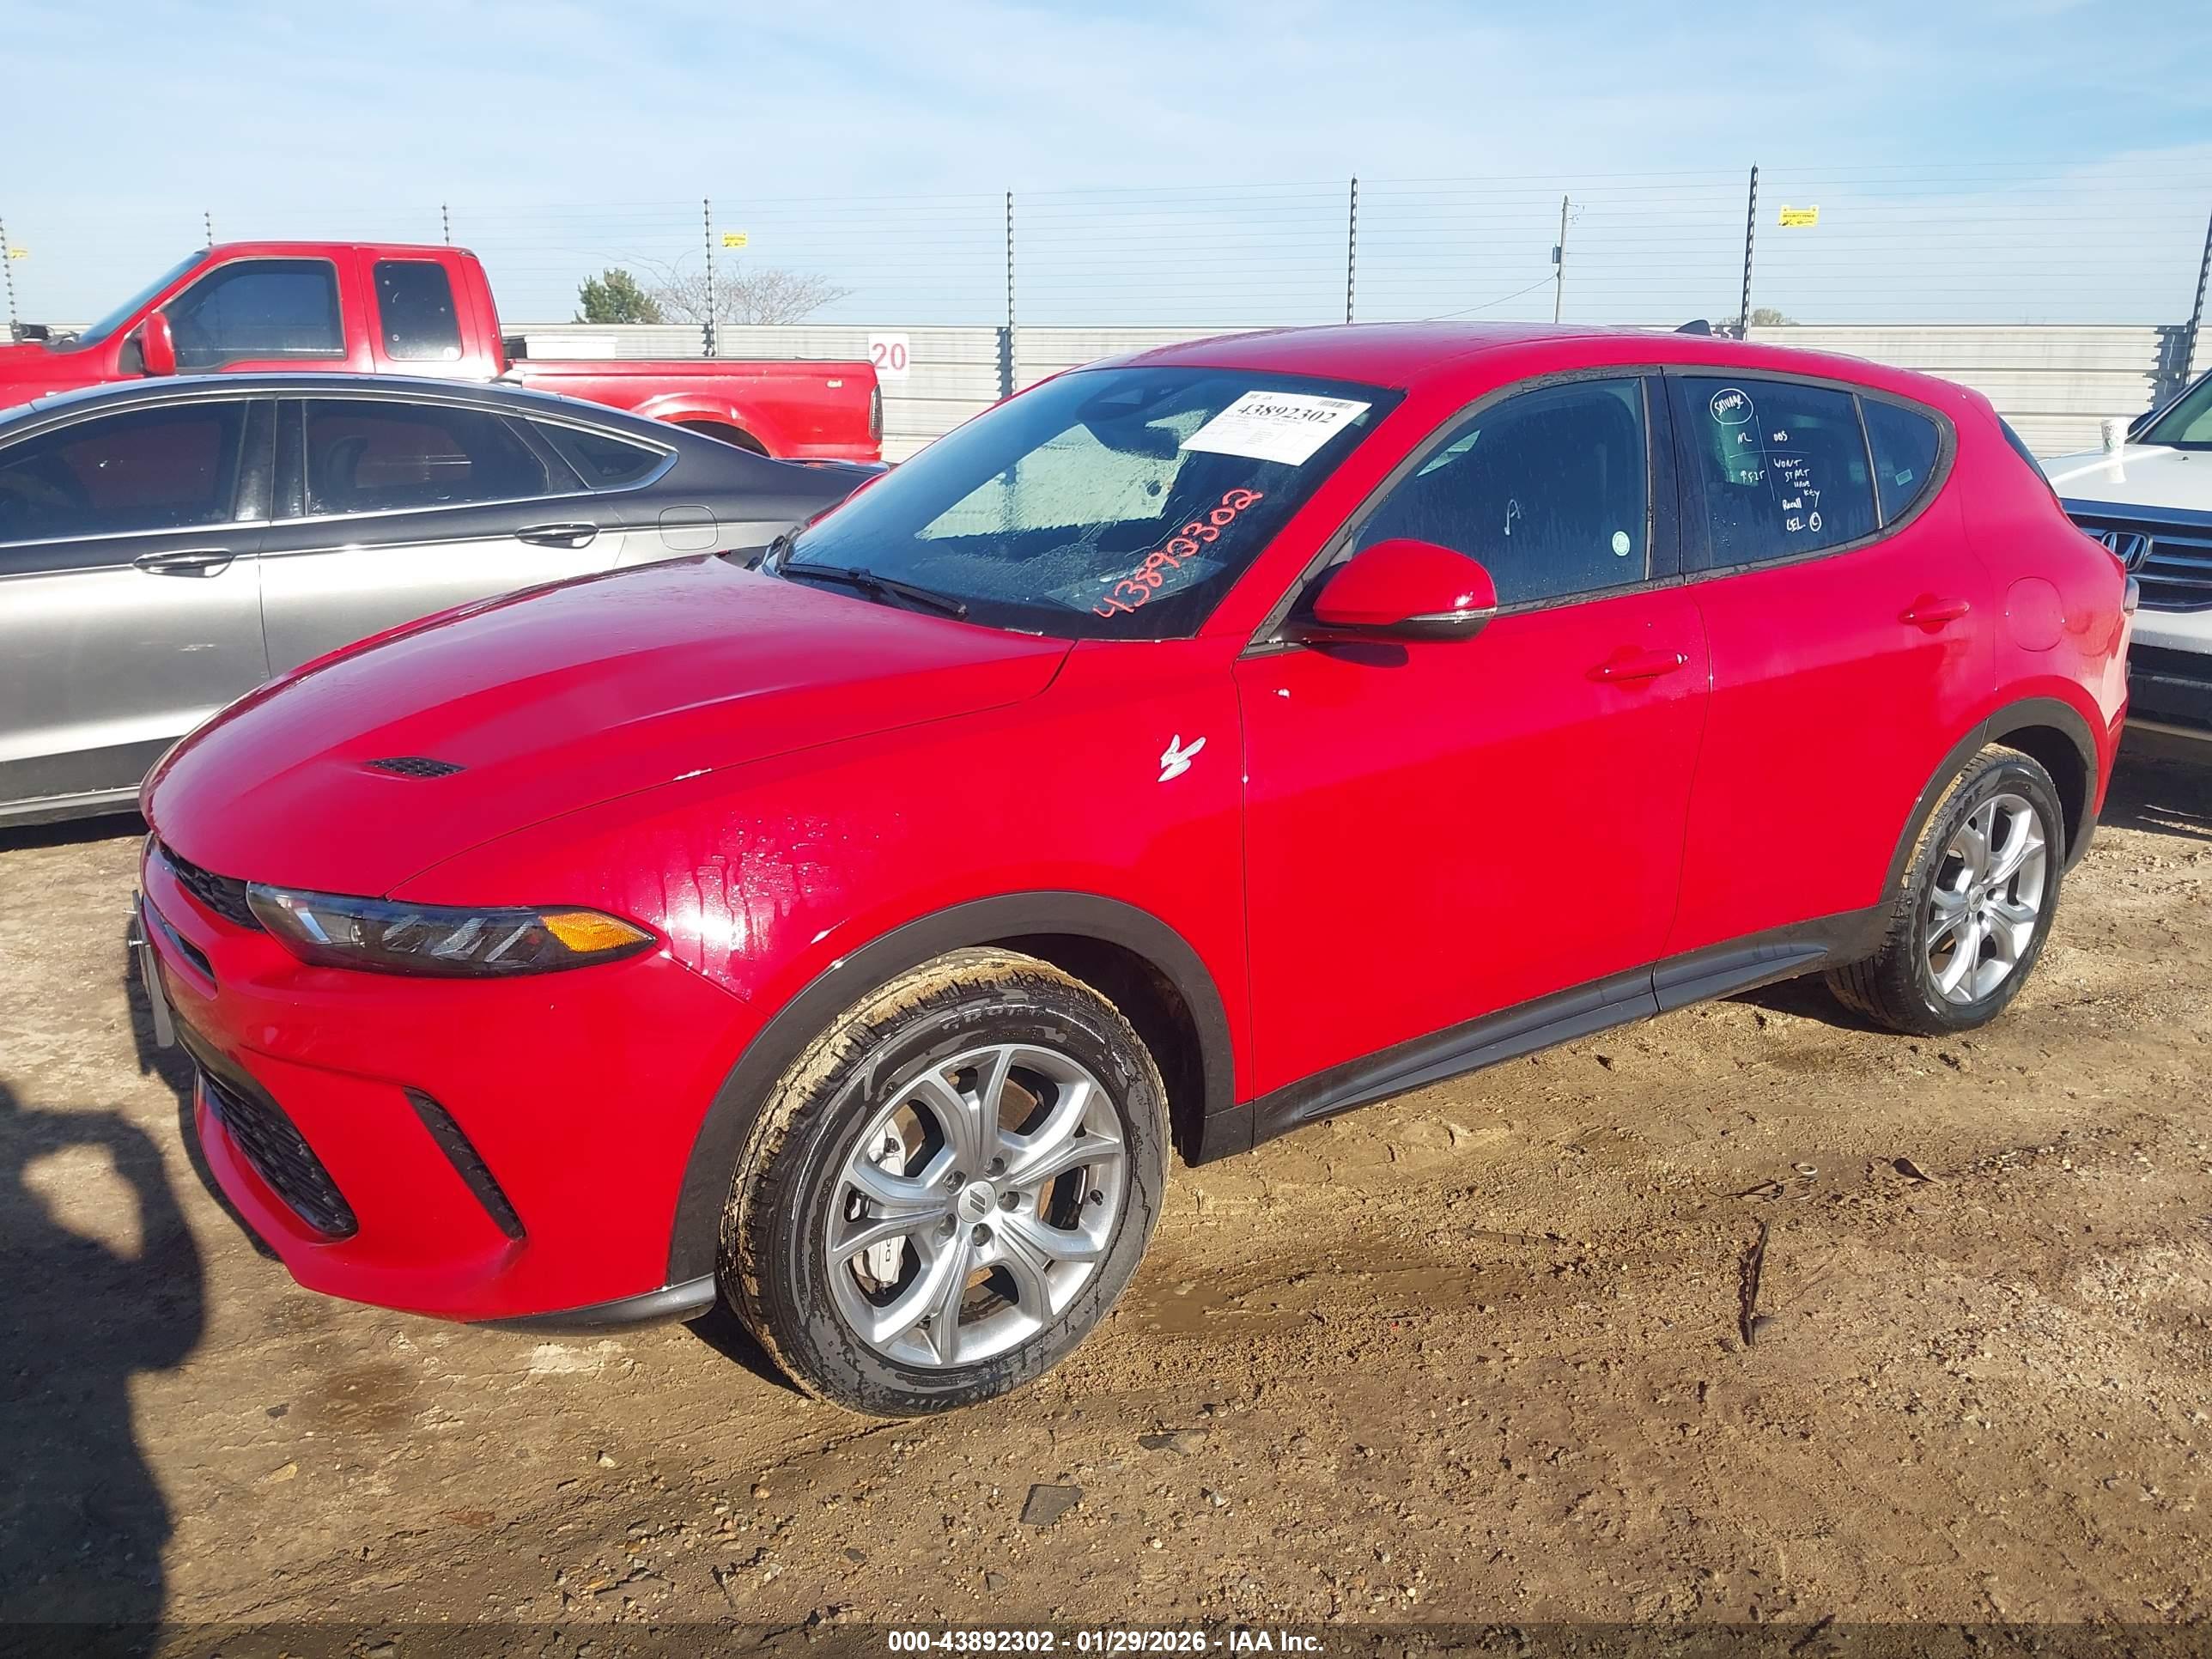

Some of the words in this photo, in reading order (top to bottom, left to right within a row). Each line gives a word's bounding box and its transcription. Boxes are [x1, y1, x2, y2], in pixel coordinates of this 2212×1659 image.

[872, 343, 906, 371] 20
[1237, 404, 1337, 423] 43892302
[1092, 489, 1263, 618] 43892302
